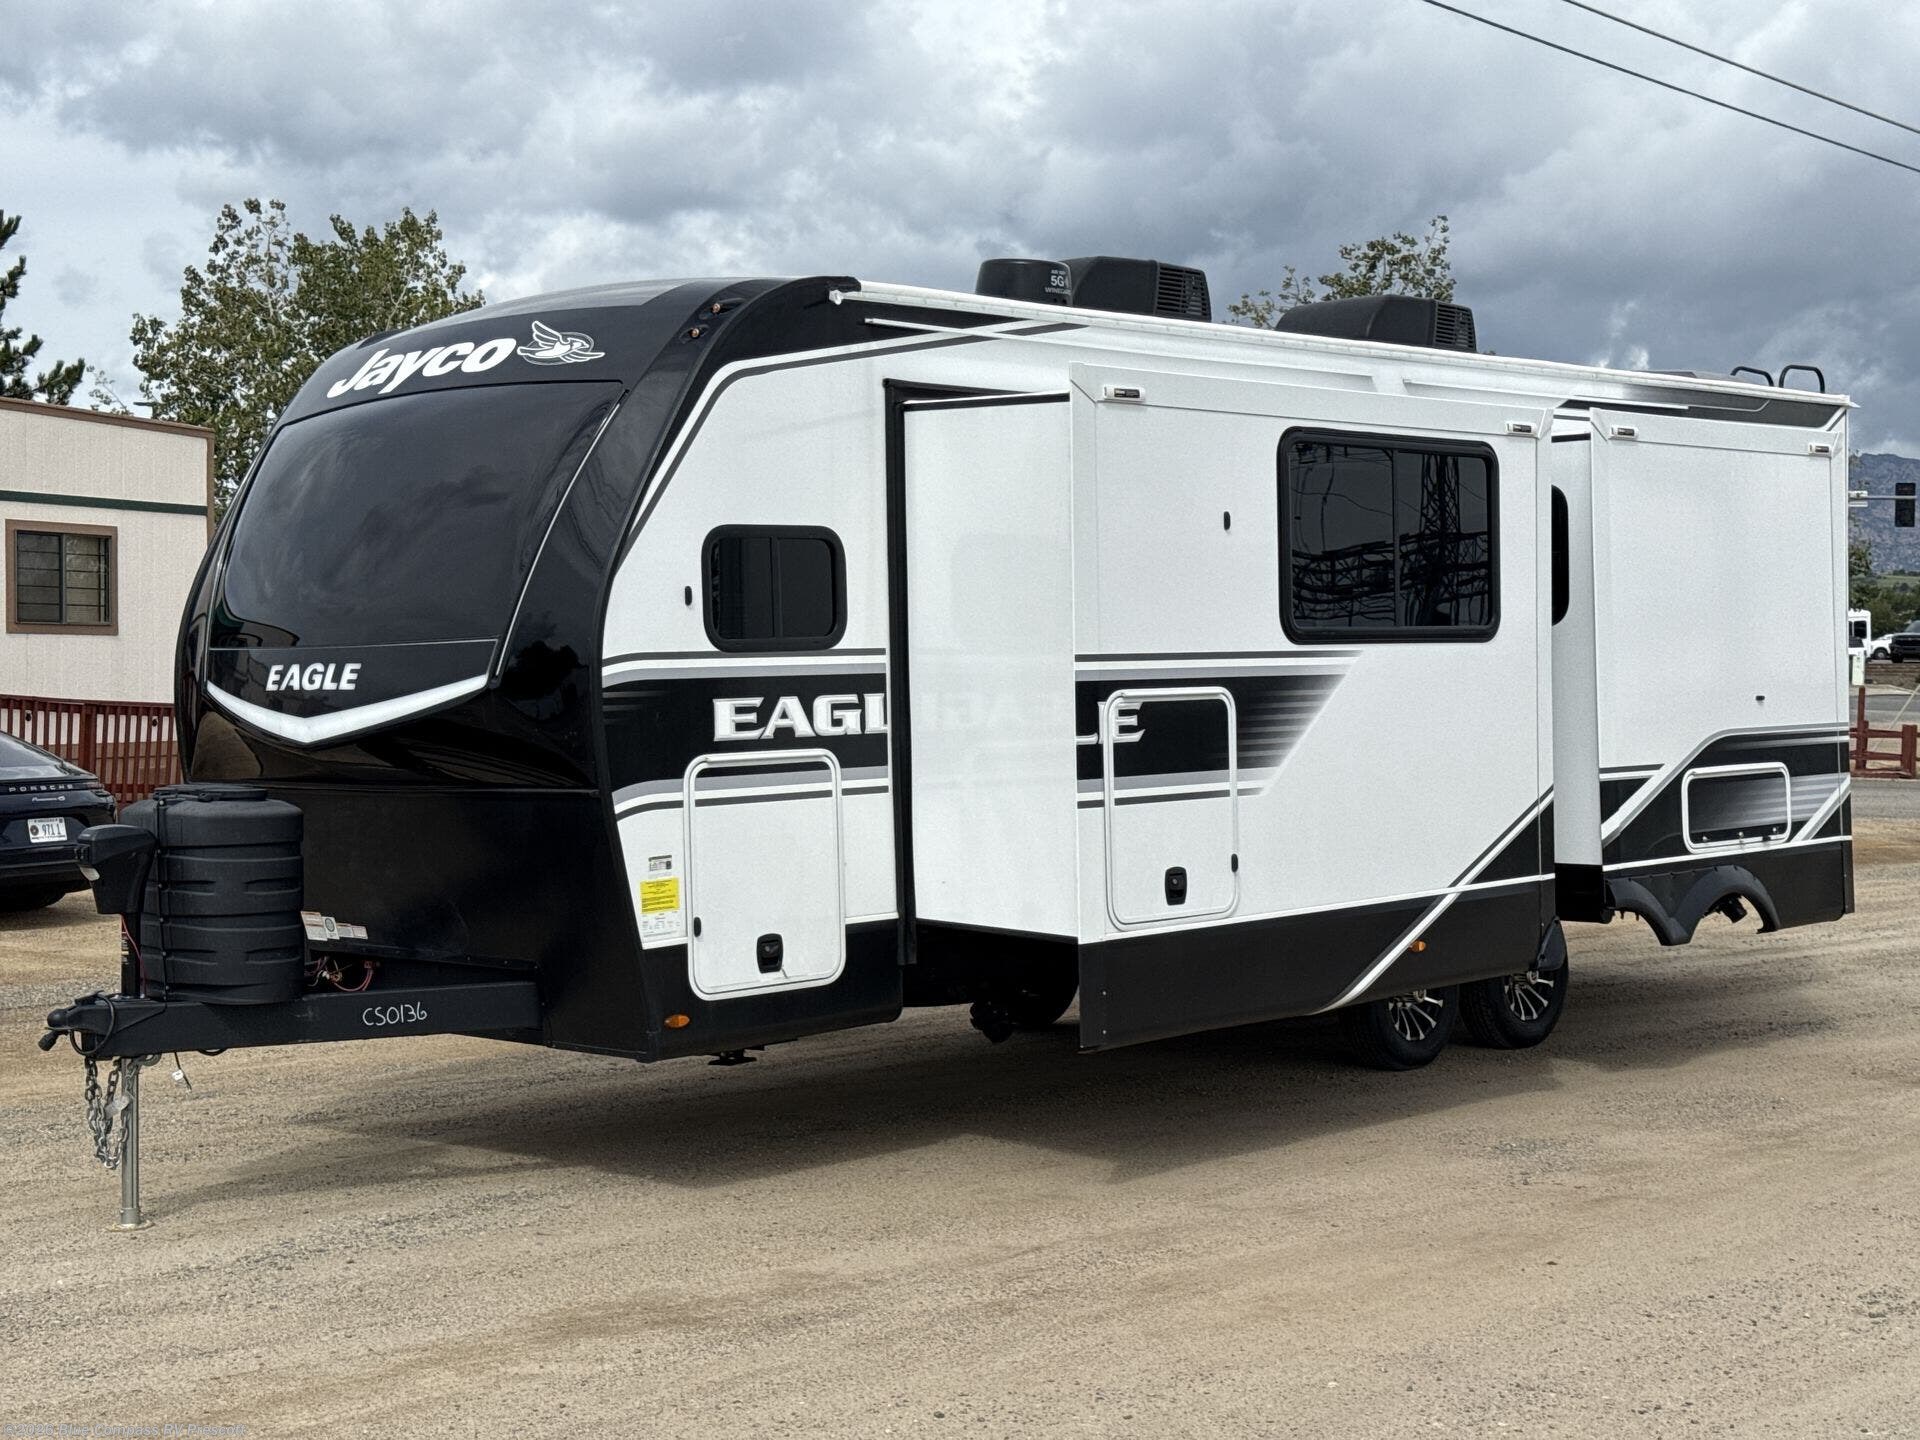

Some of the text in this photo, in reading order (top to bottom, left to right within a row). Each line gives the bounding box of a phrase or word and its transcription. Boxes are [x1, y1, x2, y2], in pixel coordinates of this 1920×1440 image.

[1050, 275, 1065, 287] 5G
[327, 337, 517, 399] Jayco
[265, 662, 362, 692] EAGLE
[362, 1001, 428, 1026] CS0136
